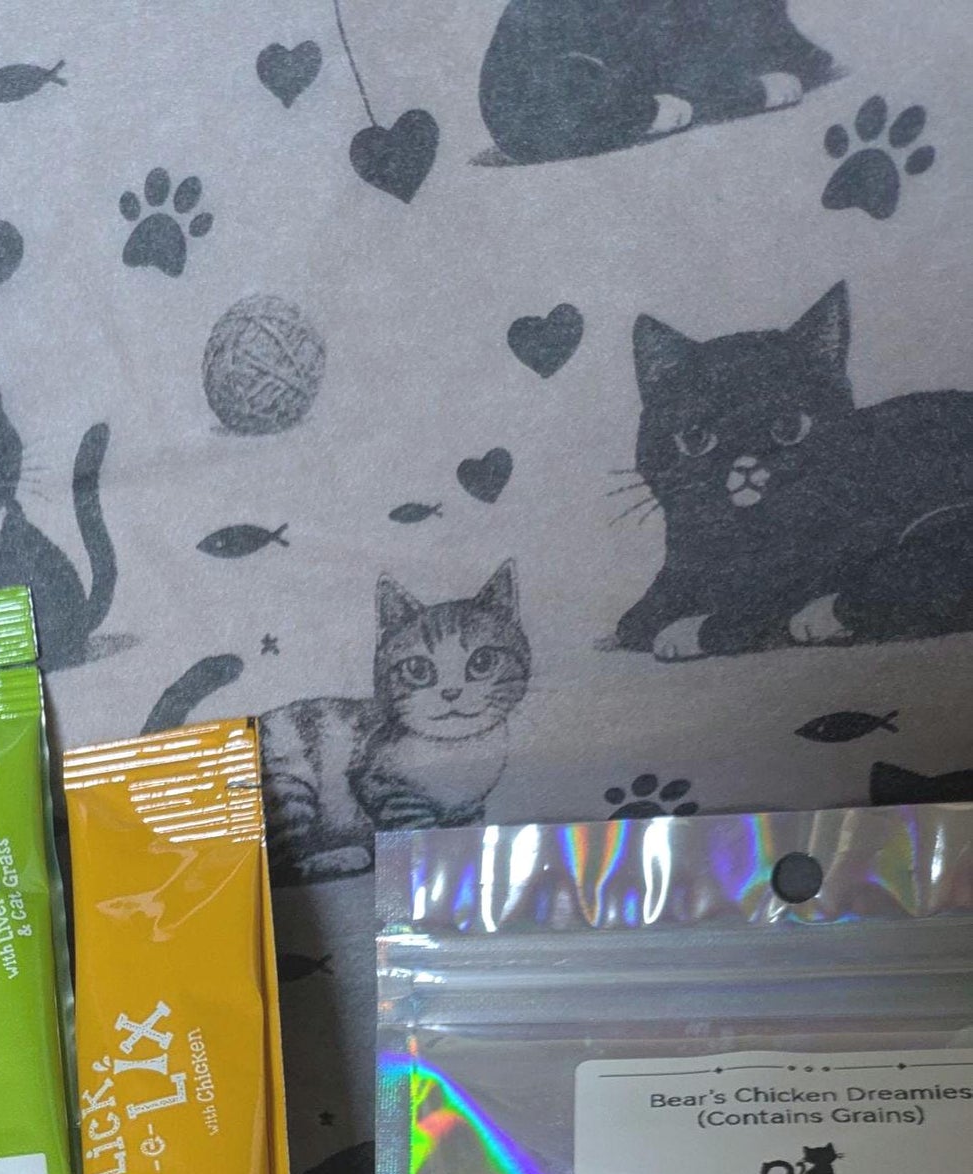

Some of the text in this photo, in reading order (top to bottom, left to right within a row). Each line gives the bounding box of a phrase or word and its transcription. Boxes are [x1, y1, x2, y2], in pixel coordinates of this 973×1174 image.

[7, 890, 27, 920] Cat
[17, 924, 33, 937] &
[0, 944, 20, 980] with
[650, 1084, 972, 1108] Bear's Chicken Dreamies
[201, 1104, 220, 1136] with
[697, 1104, 926, 1129] (Contains Grains)
